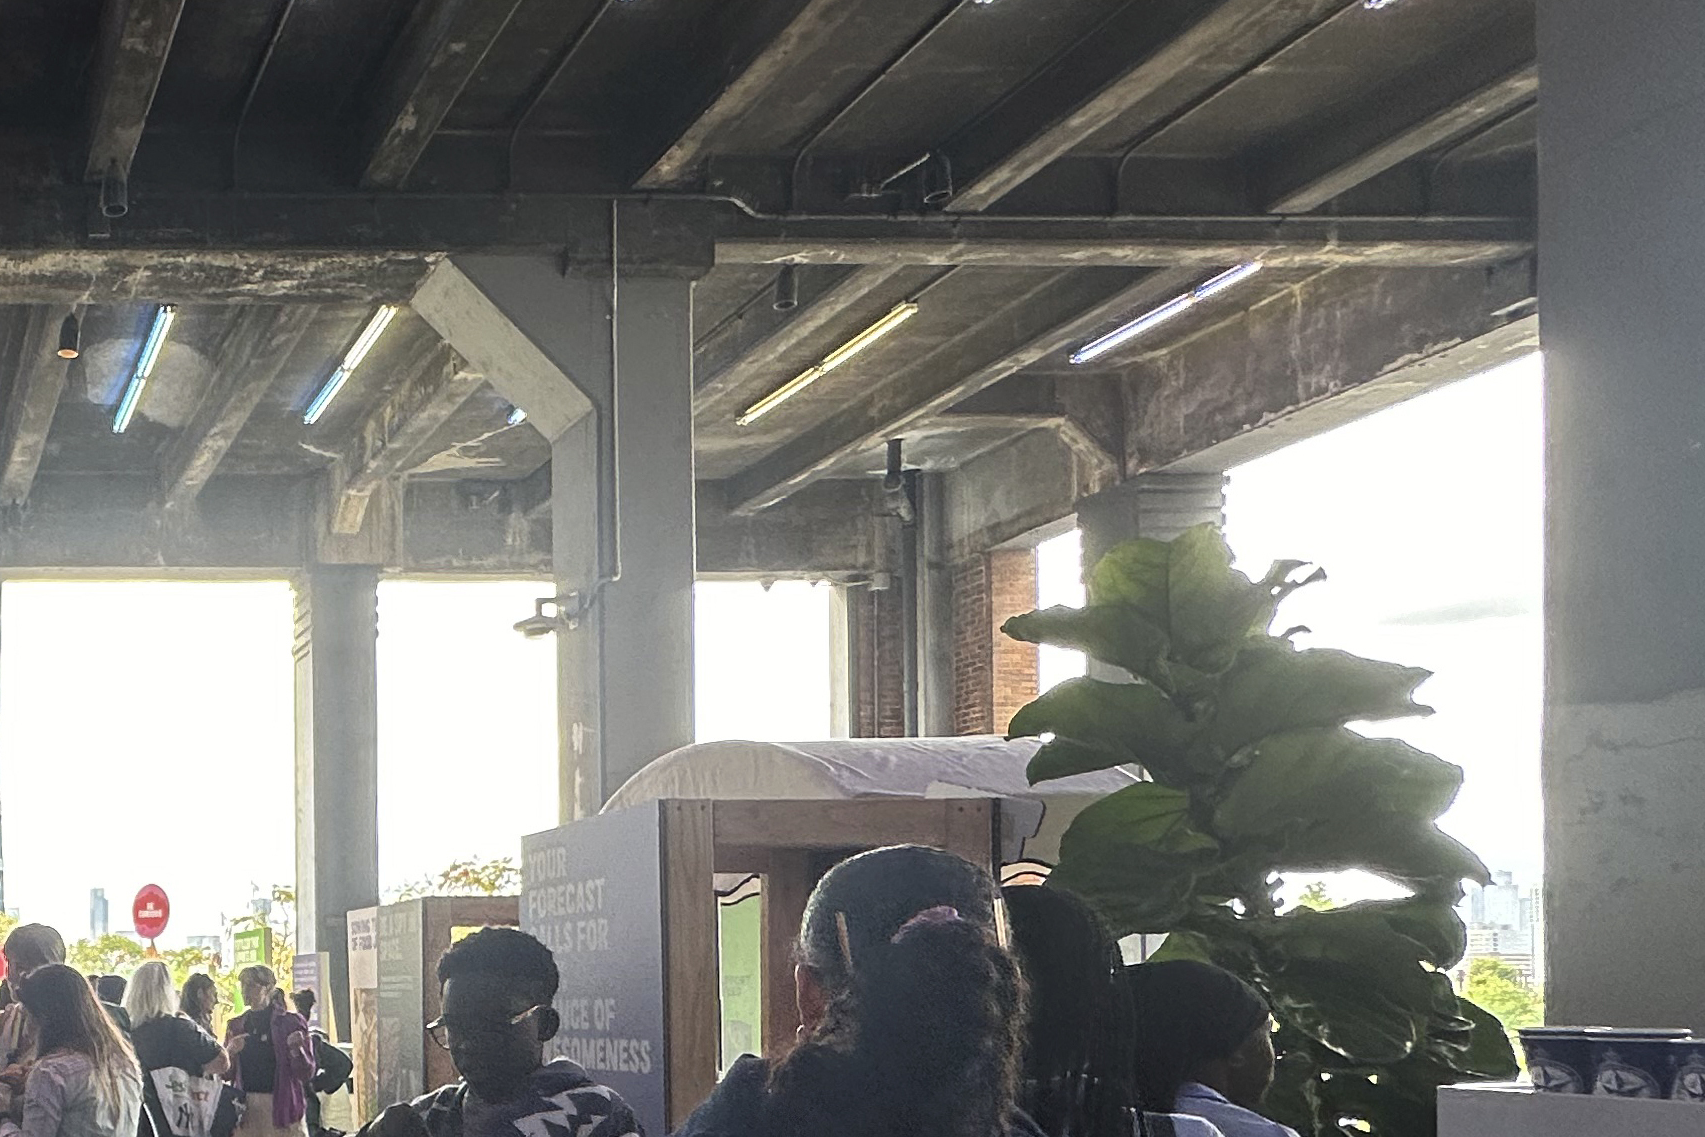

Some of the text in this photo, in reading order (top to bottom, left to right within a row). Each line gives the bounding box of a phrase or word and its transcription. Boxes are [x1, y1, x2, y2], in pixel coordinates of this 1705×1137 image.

[528, 846, 568, 883] YOUR
[528, 878, 605, 923] FORECAST
[577, 917, 609, 952] FOR
[594, 998, 616, 1031] OF
